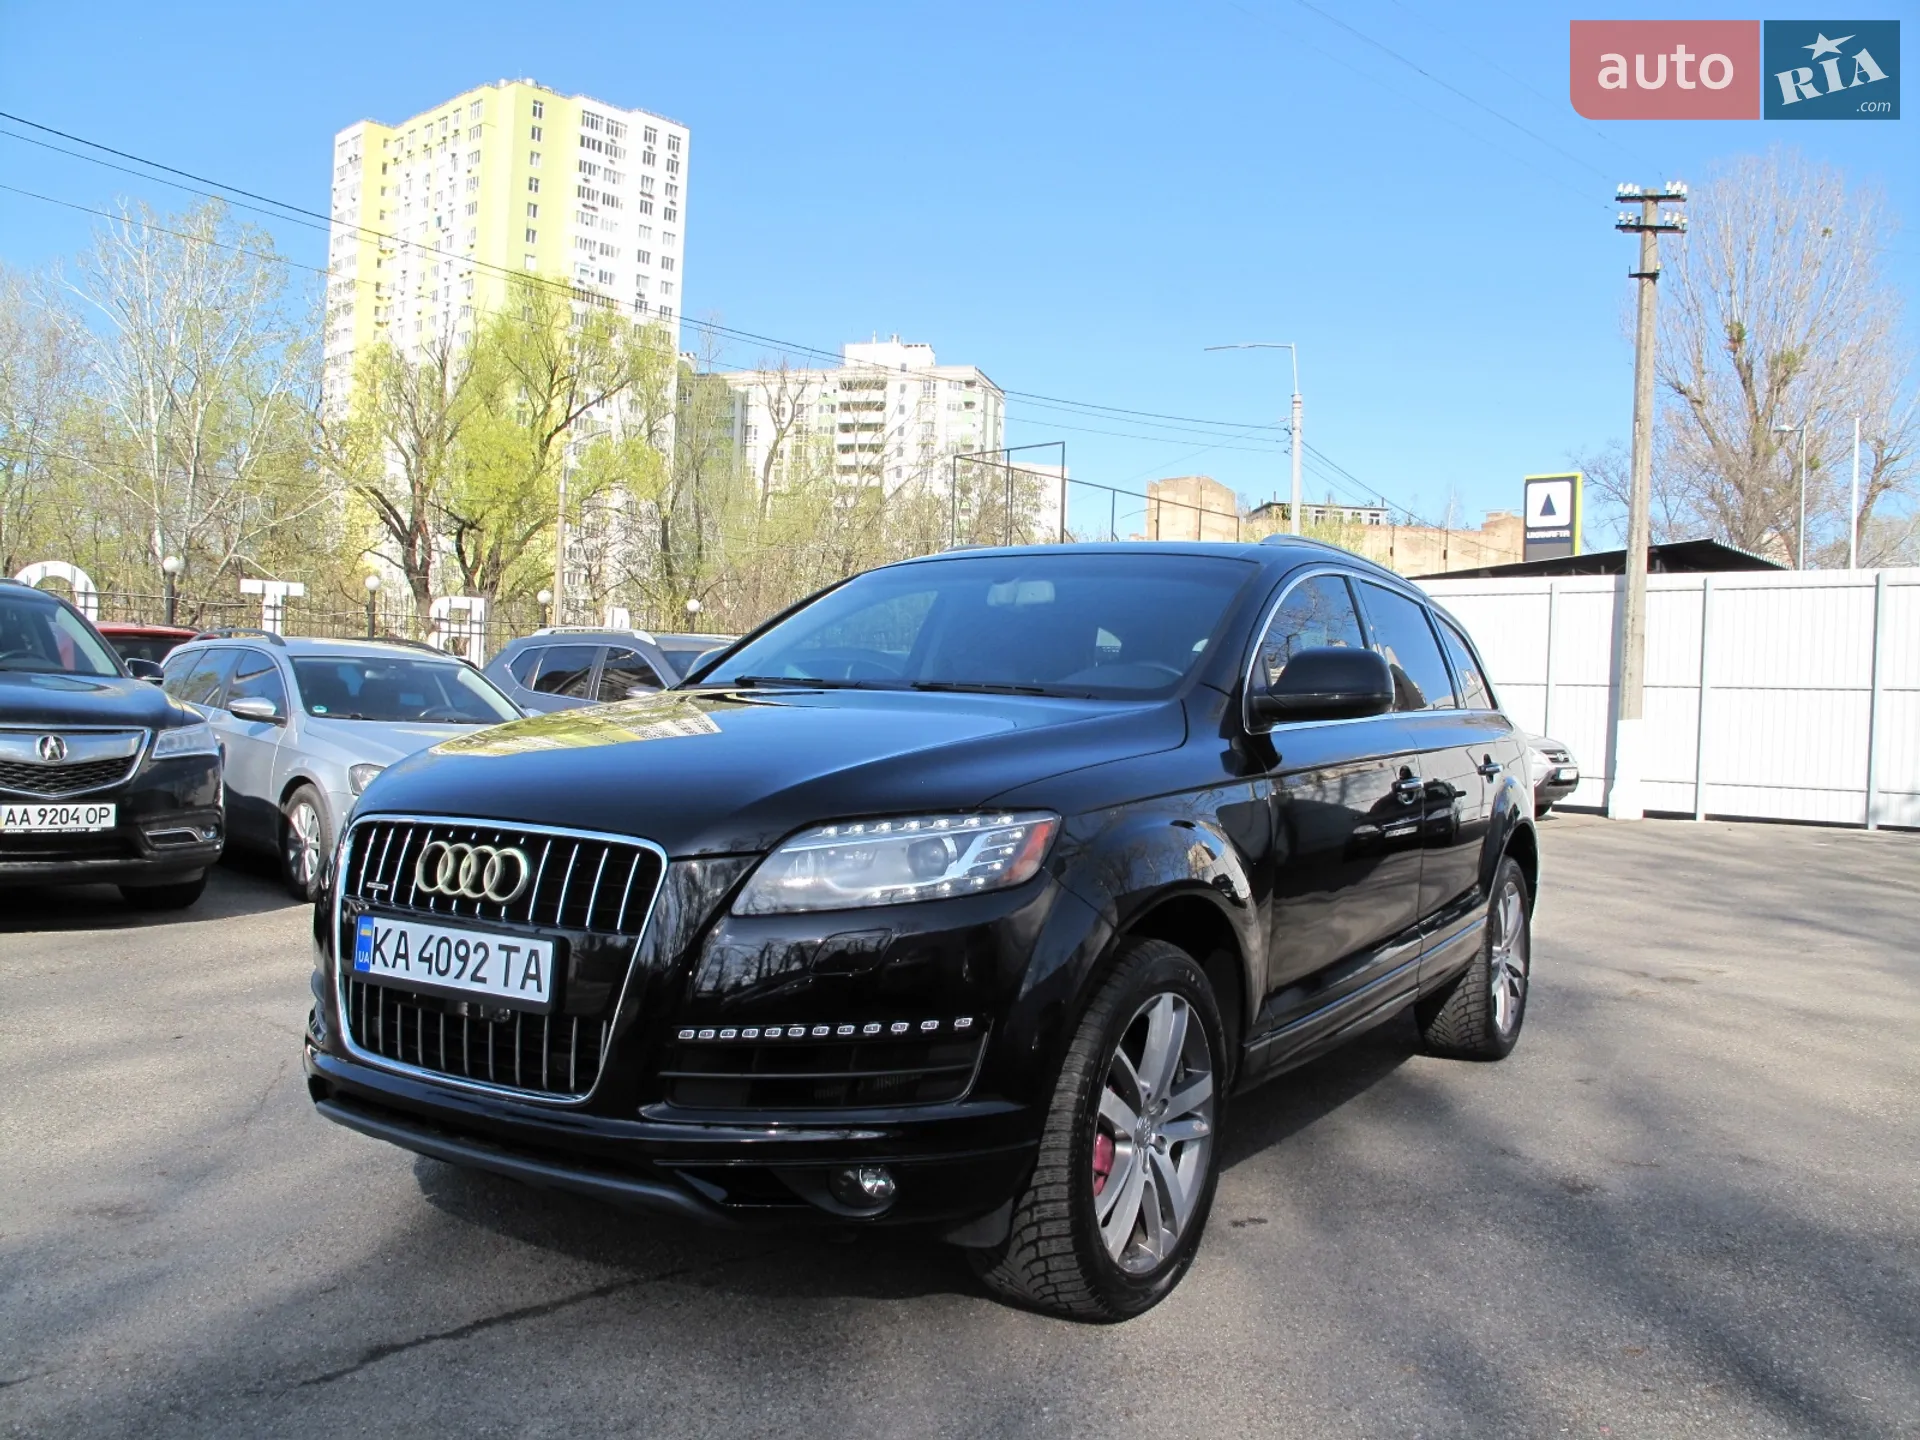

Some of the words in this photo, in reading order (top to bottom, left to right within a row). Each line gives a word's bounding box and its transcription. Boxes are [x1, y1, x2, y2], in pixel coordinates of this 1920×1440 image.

[4, 808, 31, 826] AA
[37, 807, 80, 826] 9204
[86, 807, 110, 825] OP
[358, 952, 369, 963] UA
[372, 926, 411, 971] KA
[418, 934, 489, 984] 4092
[498, 943, 542, 993] TA
